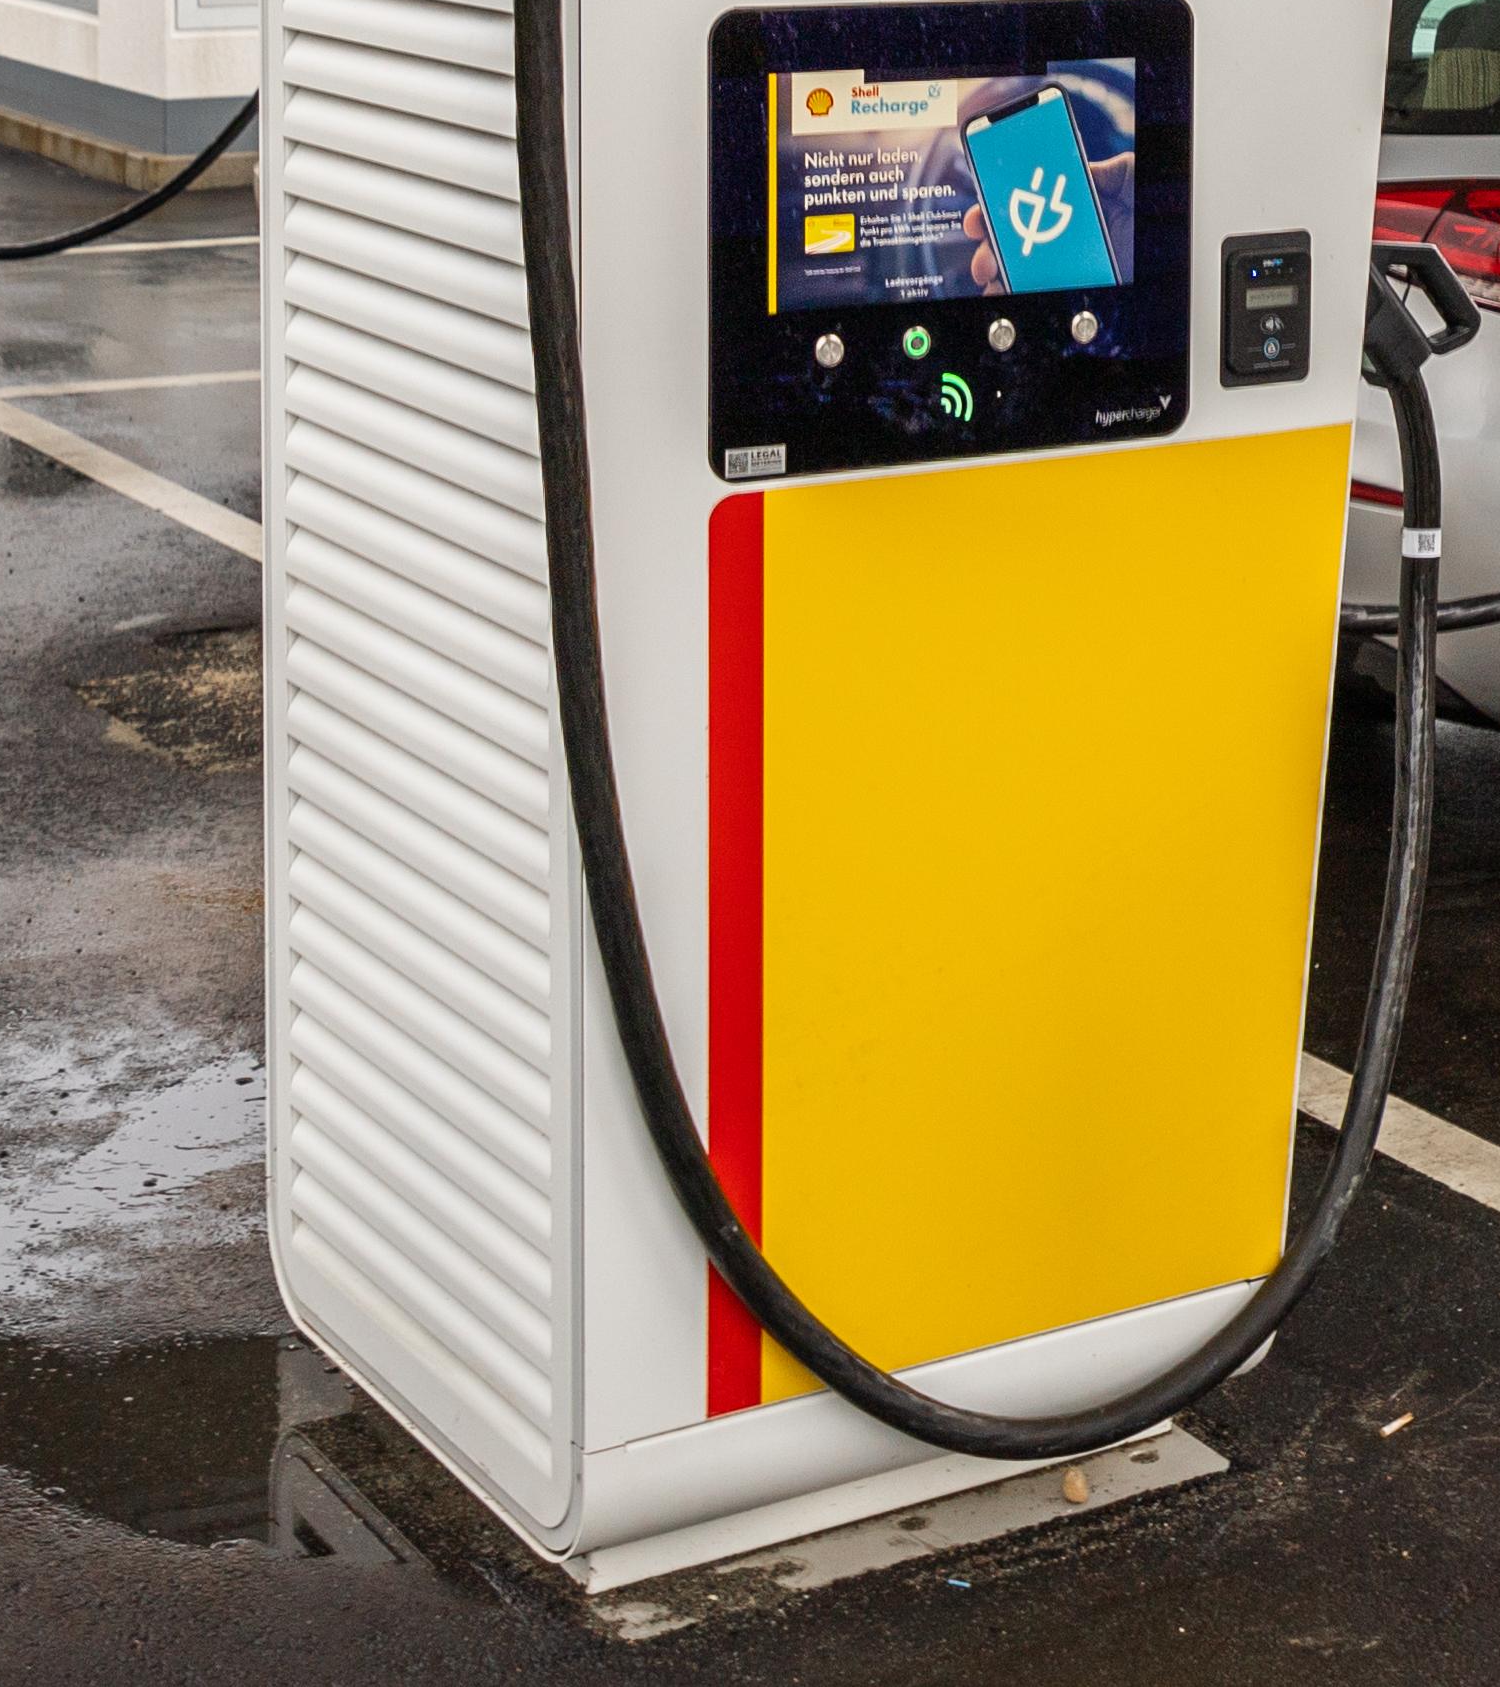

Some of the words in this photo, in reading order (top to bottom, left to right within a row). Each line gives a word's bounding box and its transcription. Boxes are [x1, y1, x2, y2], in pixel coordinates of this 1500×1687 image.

[851, 85, 880, 98] Shell
[851, 97, 929, 116] Recharge
[804, 150, 845, 169] Nicht
[848, 152, 874, 166] nur
[877, 146, 922, 165] laden,
[804, 168, 865, 188] sondern
[869, 165, 905, 184] auch
[804, 187, 866, 210] punkten
[870, 183, 898, 202] und
[901, 183, 957, 203] sparen.
[906, 288, 929, 299] aktiv
